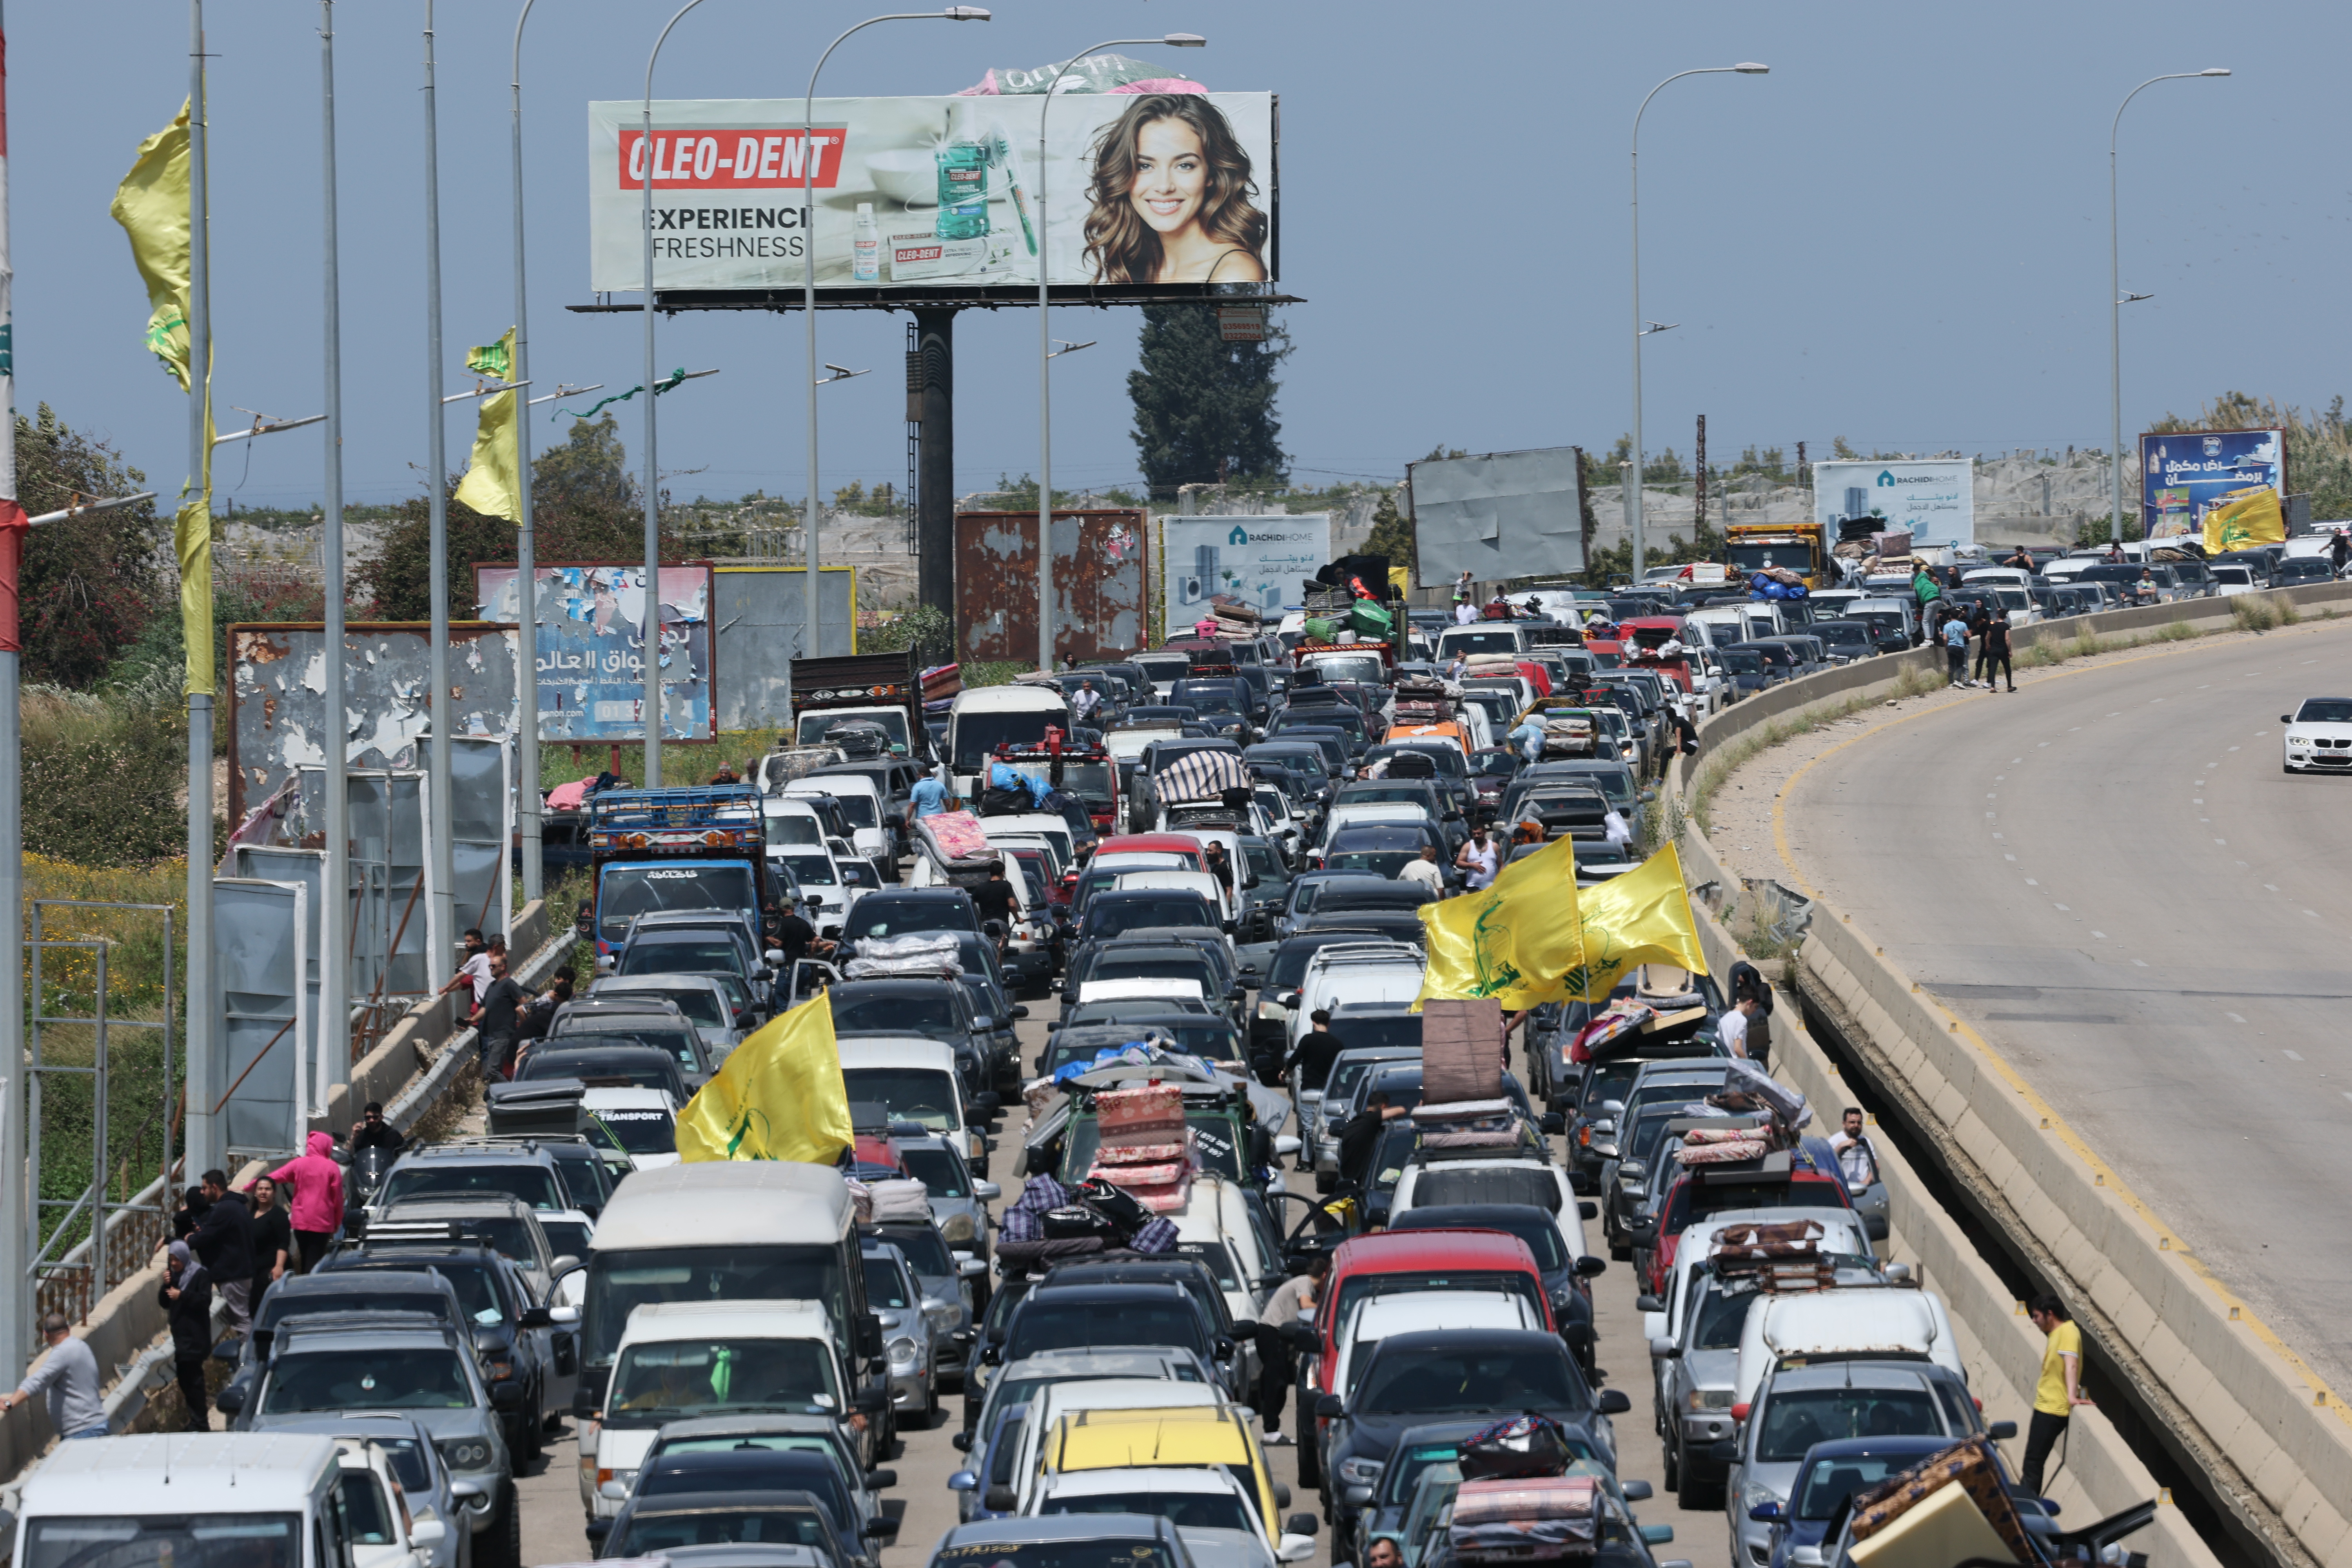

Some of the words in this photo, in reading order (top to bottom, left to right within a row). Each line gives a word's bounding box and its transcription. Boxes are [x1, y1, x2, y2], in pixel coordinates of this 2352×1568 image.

[652, 236, 804, 258] FRESHNESS
[897, 249, 939, 260] CLEO-DENT
[602, 706, 619, 717] 01
[599, 1112, 663, 1121] TRANSPORT
